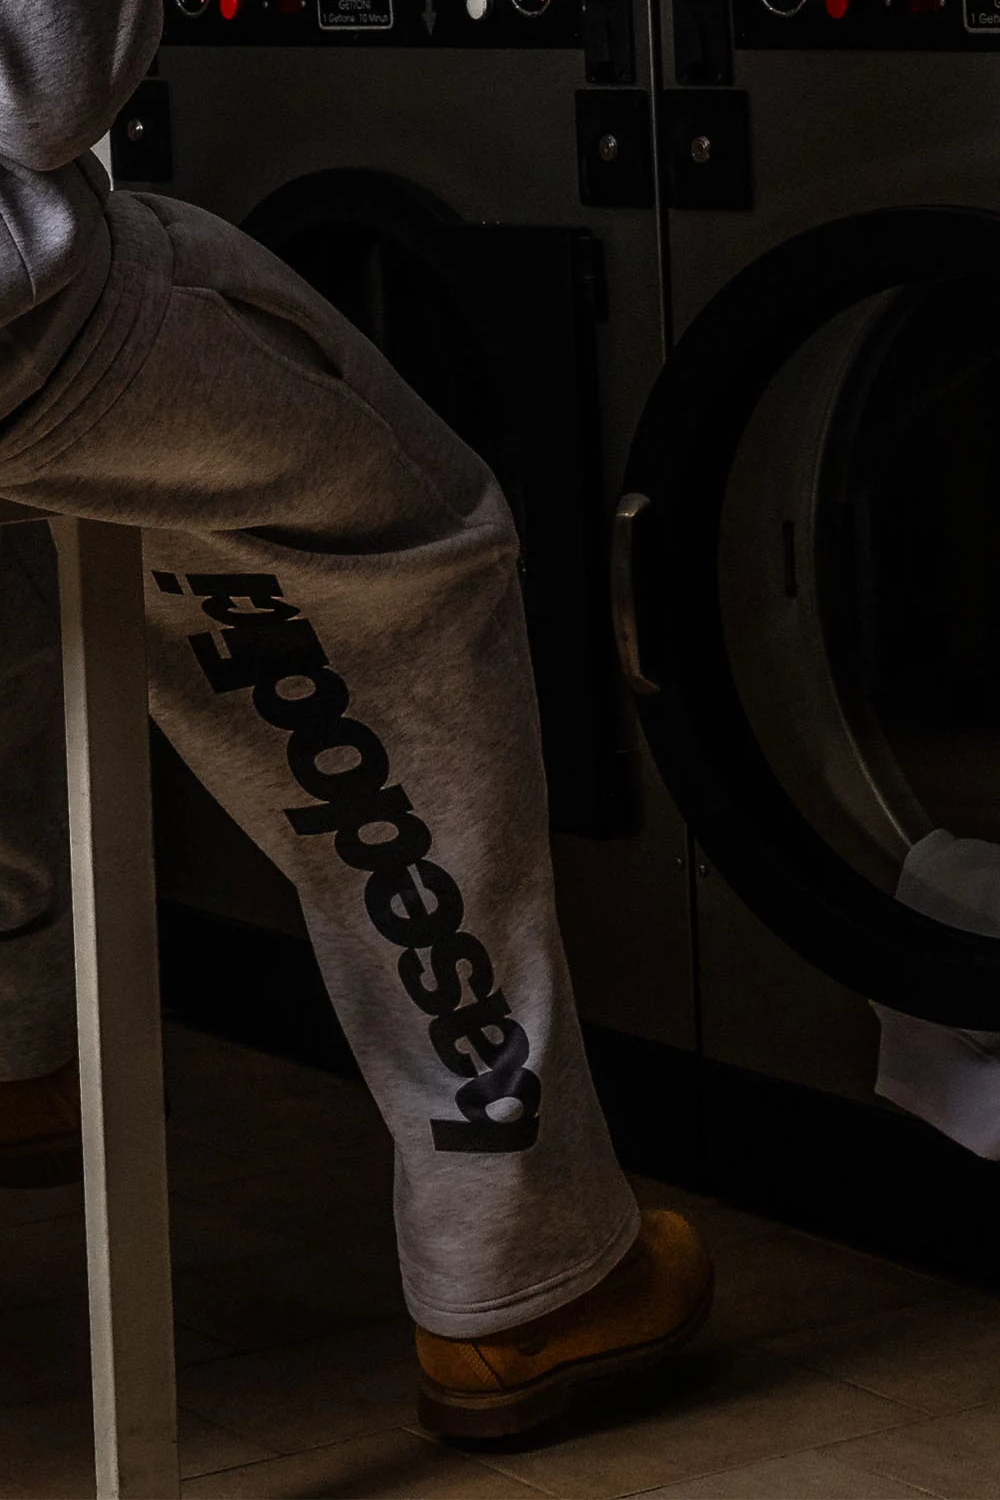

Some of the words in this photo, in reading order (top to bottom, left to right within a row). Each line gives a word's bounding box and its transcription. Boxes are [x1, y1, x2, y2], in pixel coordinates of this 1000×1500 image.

[338, 0, 372, 11] GETTONI
[328, 12, 356, 23] Gettone
[152, 570, 542, 1153] basedodici
